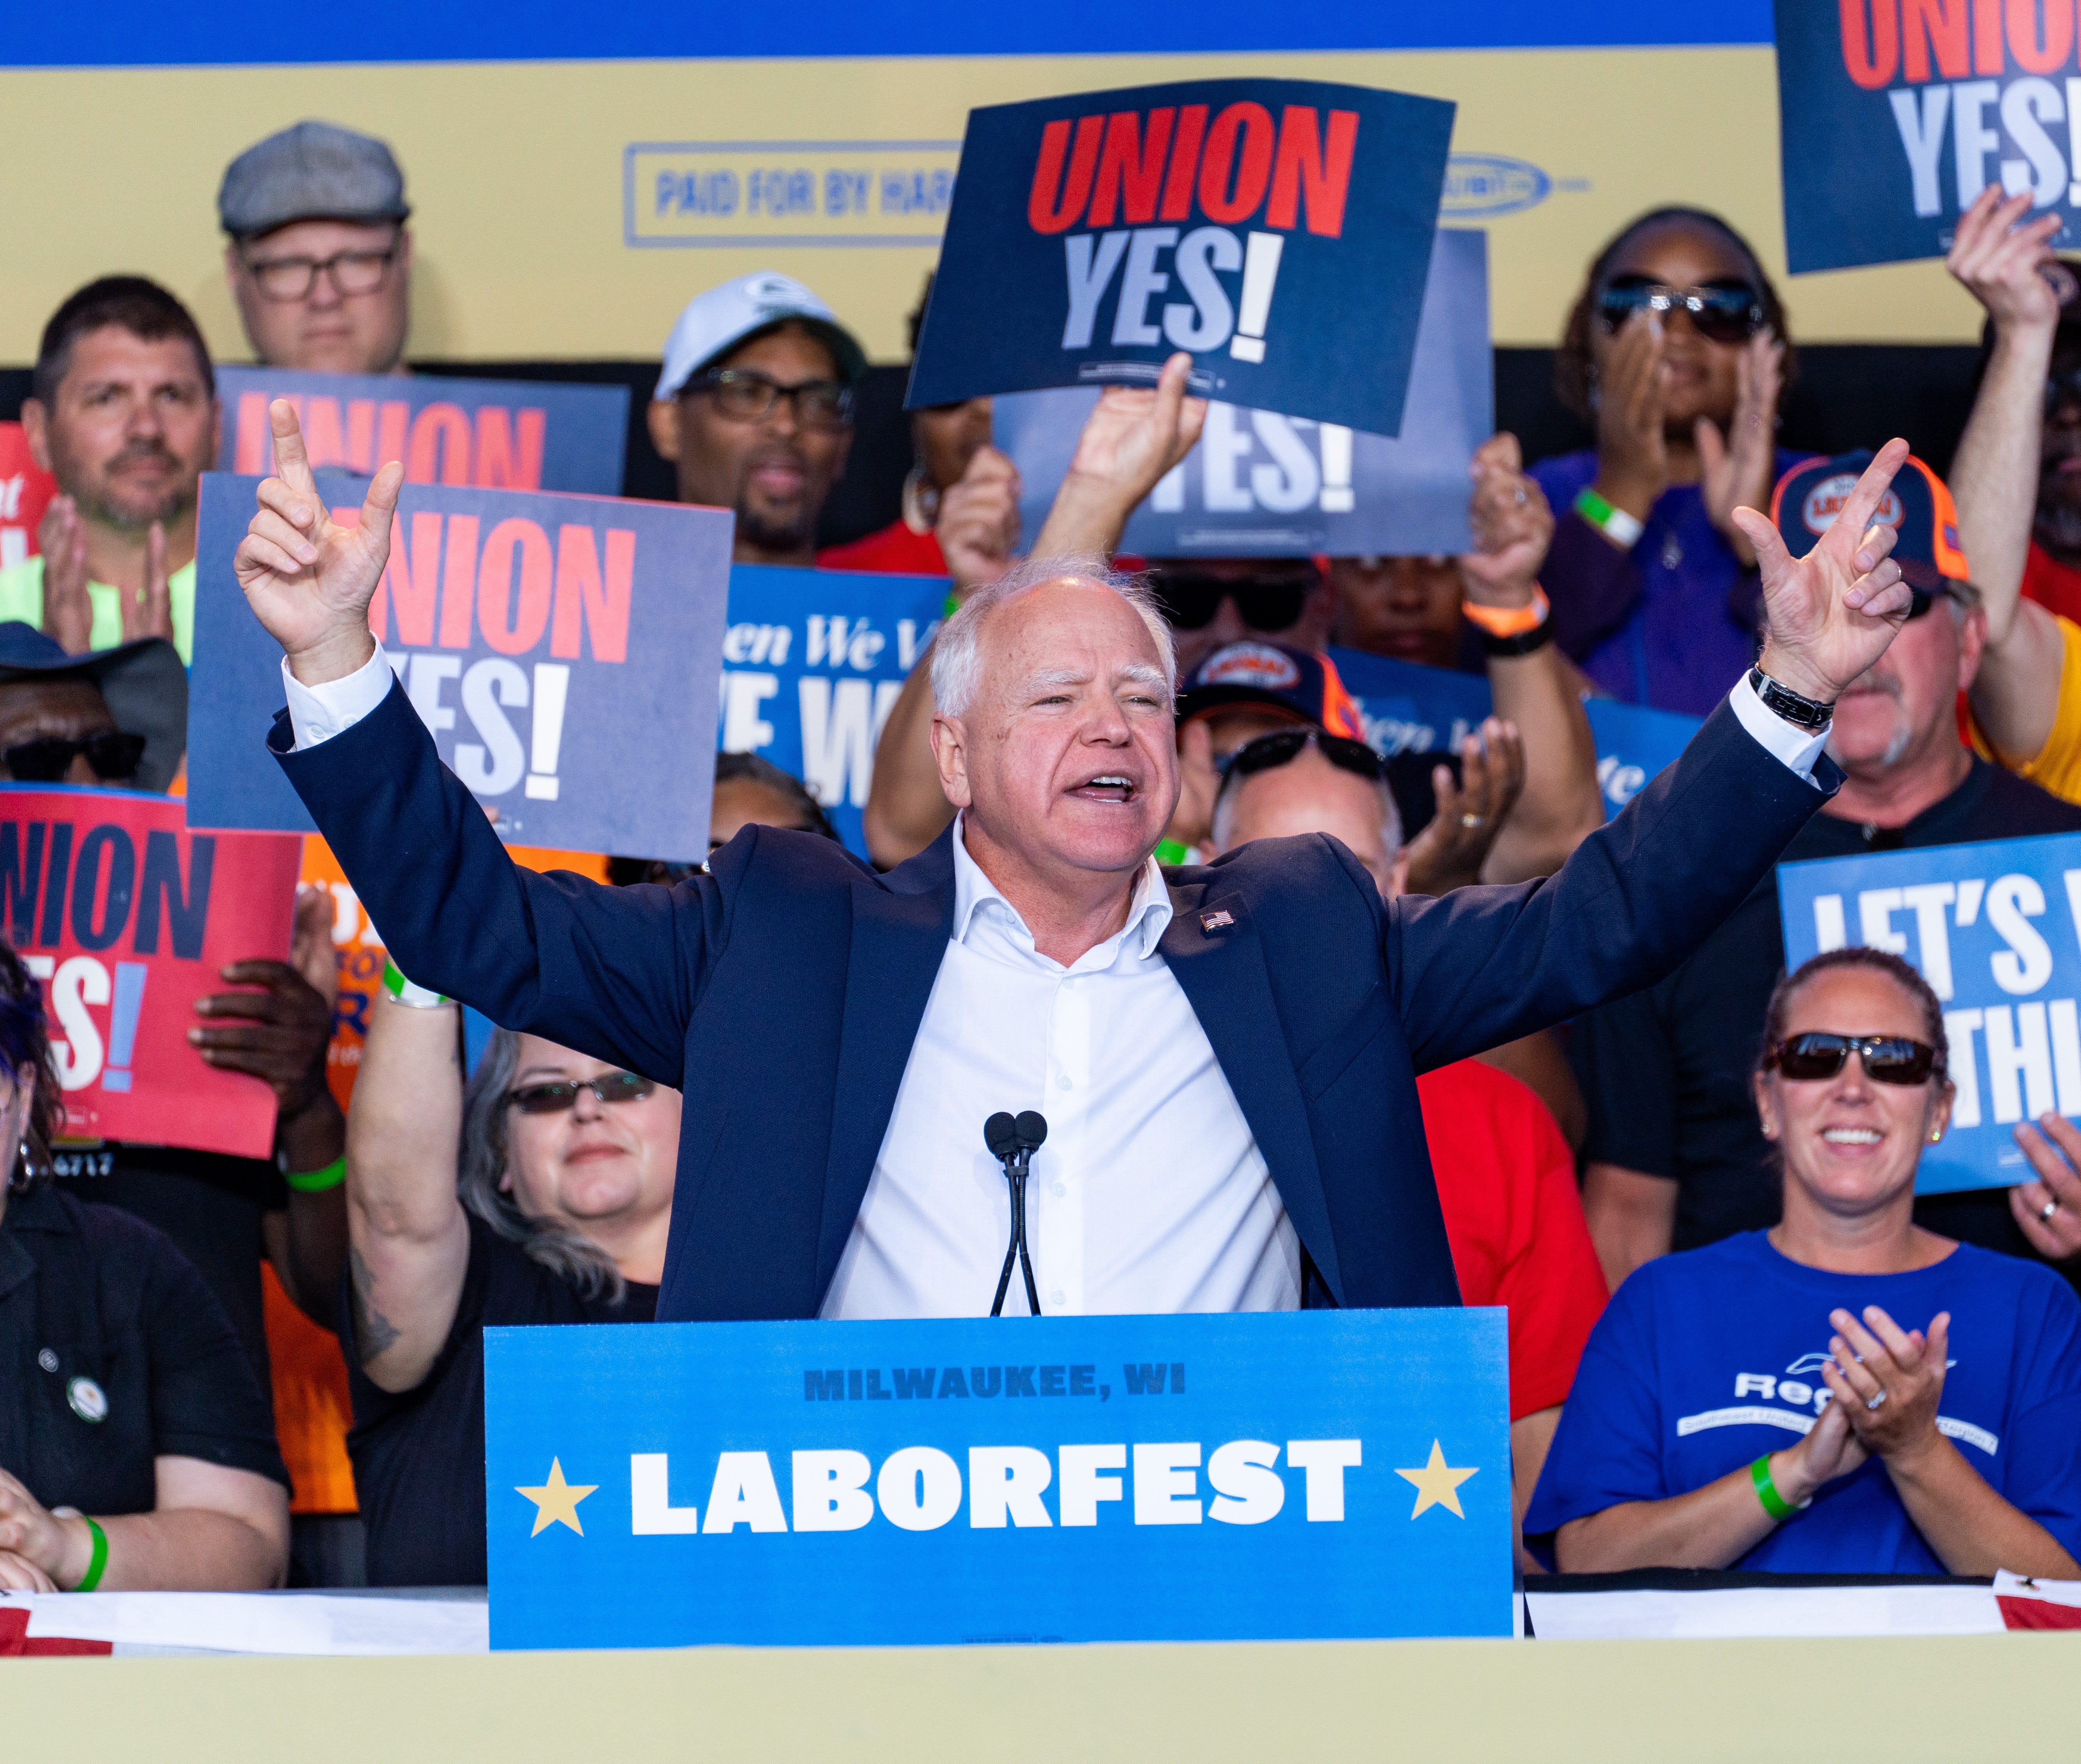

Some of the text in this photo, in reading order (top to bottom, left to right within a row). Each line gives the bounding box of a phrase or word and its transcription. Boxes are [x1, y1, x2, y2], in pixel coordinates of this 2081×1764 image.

[1838, 0, 2081, 90] UNIO
[655, 168, 740, 217] PAID
[747, 168, 817, 218] FOR
[824, 168, 873, 218] BY
[1027, 101, 1360, 239] UNION
[1061, 225, 1285, 364] YES!
[332, 507, 637, 664] NION
[806, 613, 886, 671] We
[385, 652, 570, 800] ES!
[804, 1363, 1186, 1403] MILWAUKEE, WI
[630, 1438, 1362, 1535] LABORFEST
